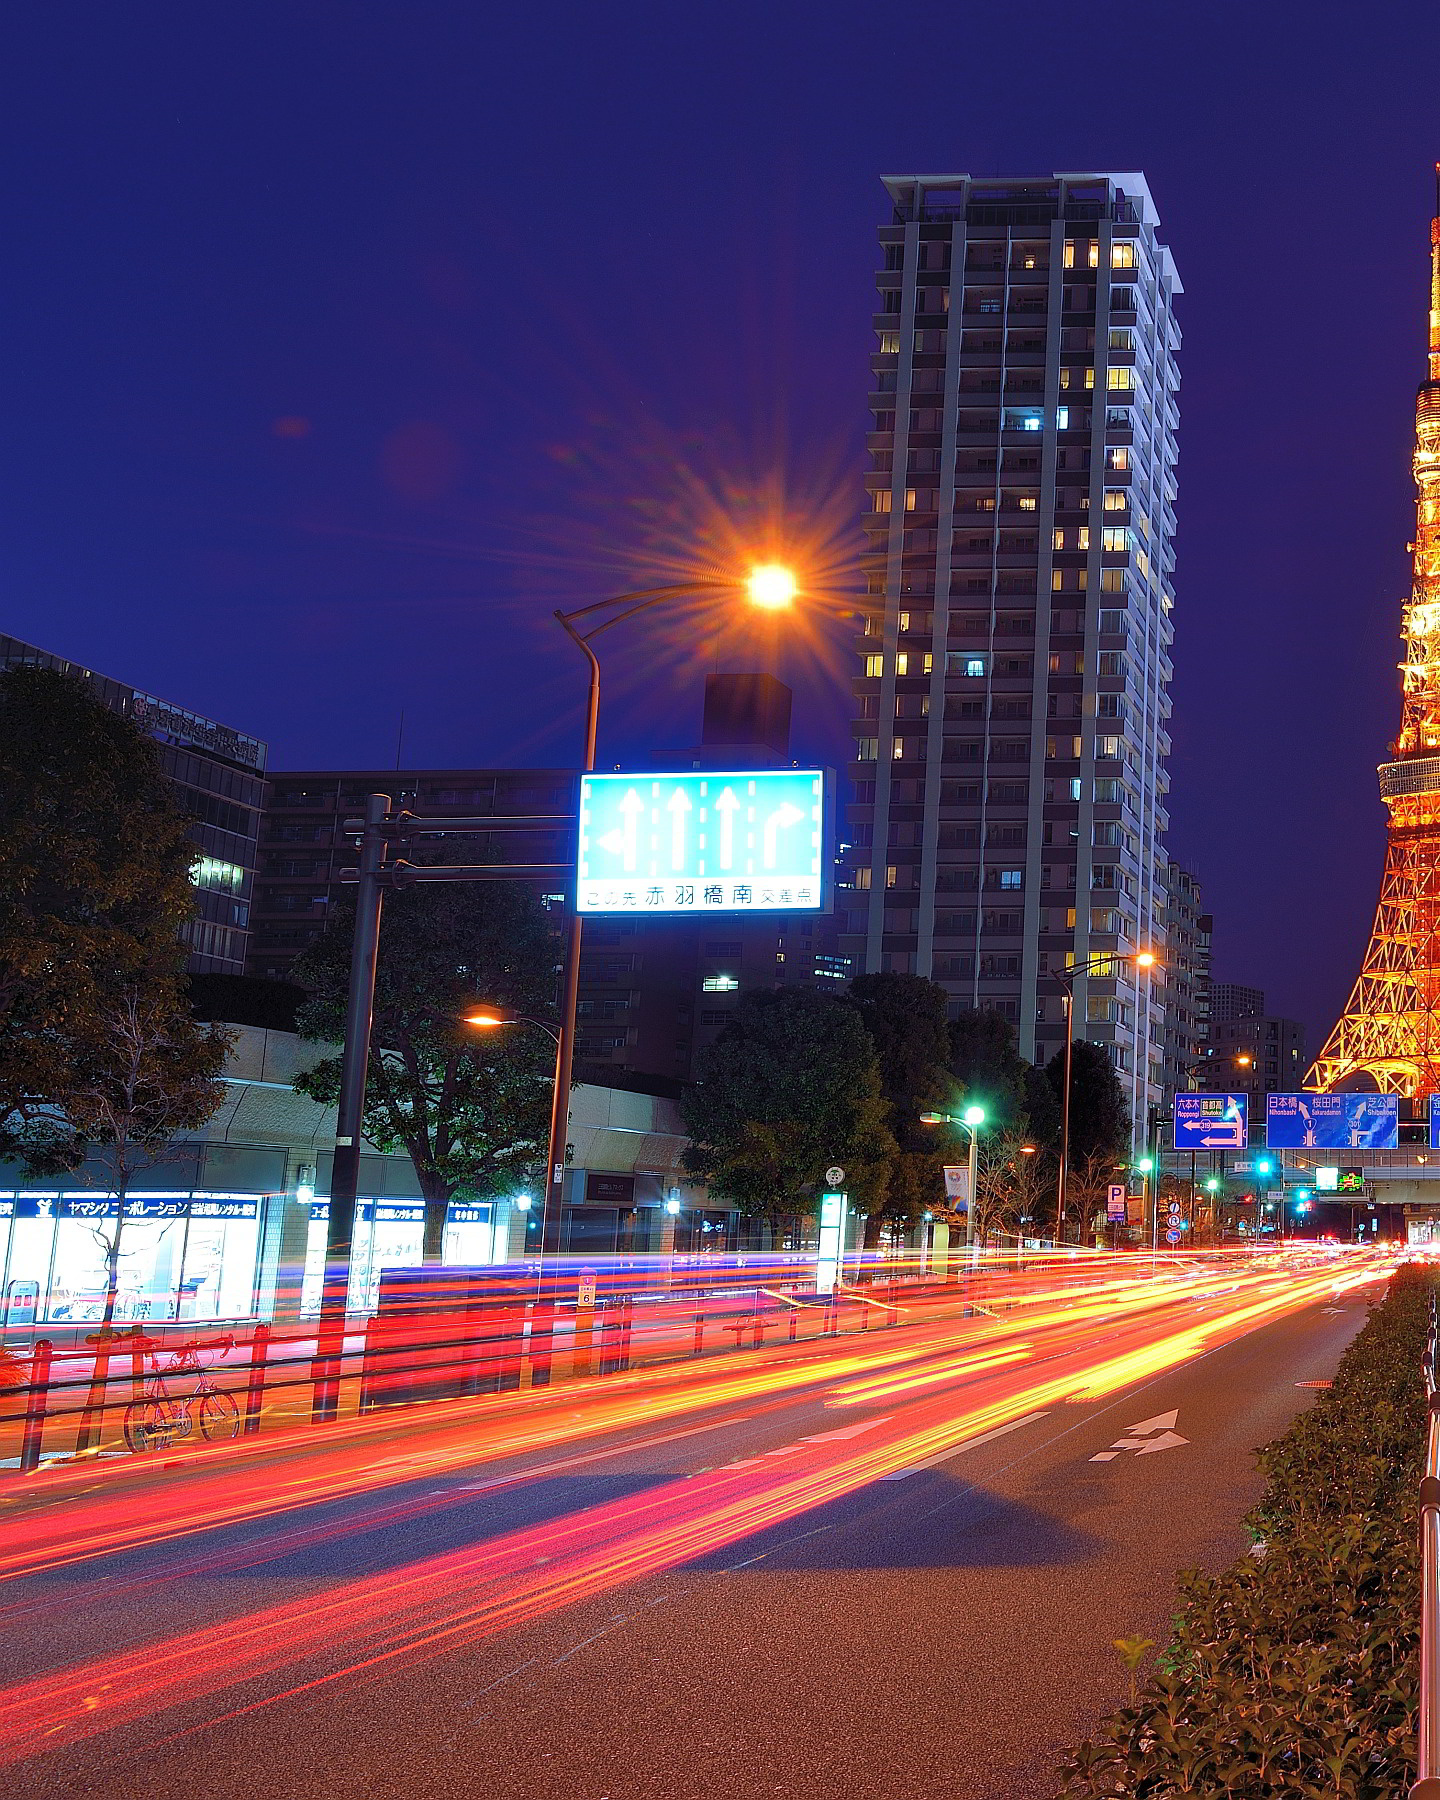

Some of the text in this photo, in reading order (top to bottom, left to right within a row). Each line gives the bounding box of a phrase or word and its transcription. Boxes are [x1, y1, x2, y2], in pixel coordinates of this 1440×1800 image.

[1177, 1098, 1200, 1110] 六本木
[1269, 1096, 1298, 1109] 日本橋
[1312, 1096, 1341, 1109] 桜田門
[1368, 1096, 1396, 1109] 芝公園
[1177, 1110, 1200, 1119] Roppongi
[1111, 1187, 1122, 1201] P
[584, 1294, 590, 1303] 6
